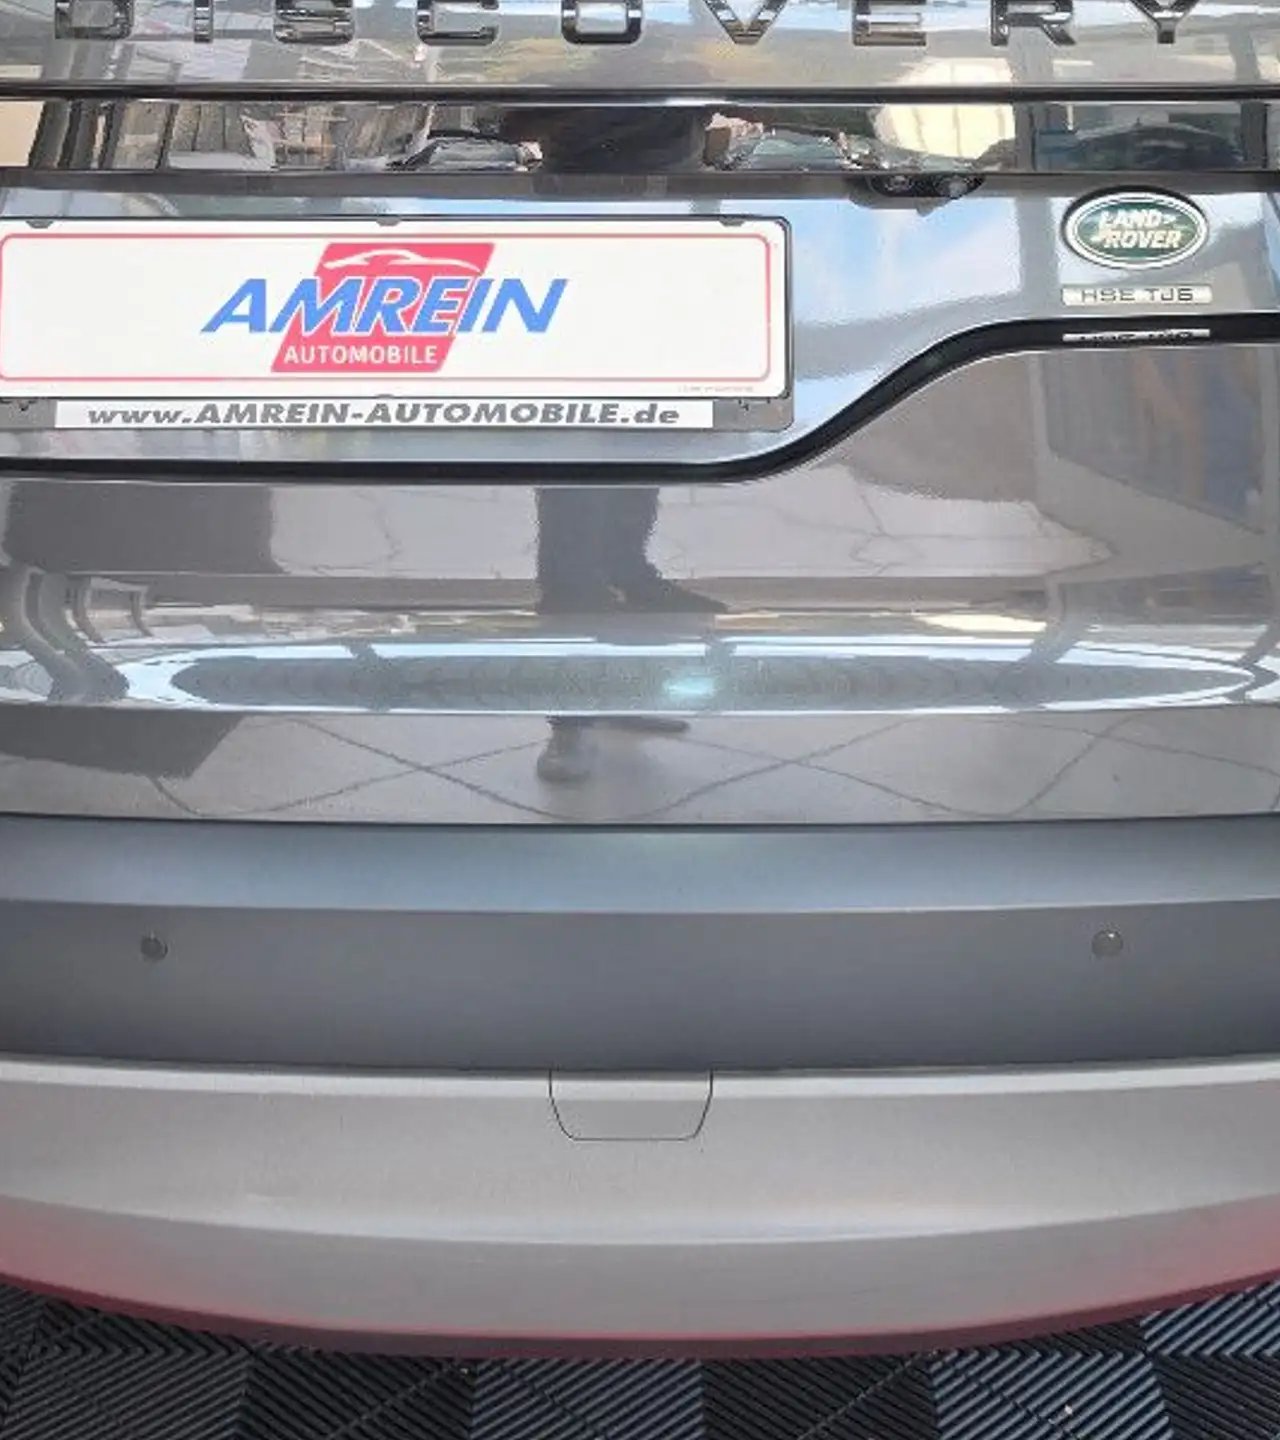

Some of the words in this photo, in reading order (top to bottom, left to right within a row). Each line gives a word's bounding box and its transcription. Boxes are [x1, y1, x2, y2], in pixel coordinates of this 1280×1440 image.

[1099, 209, 1161, 228] LAND
[1103, 230, 1181, 248] ROVER
[1081, 288, 1135, 302] HSE
[200, 277, 568, 335] AMREIN
[284, 345, 438, 365] AUTOMOBILE
[87, 402, 680, 425] www.AMREIN-AUTOMOBILE.de
